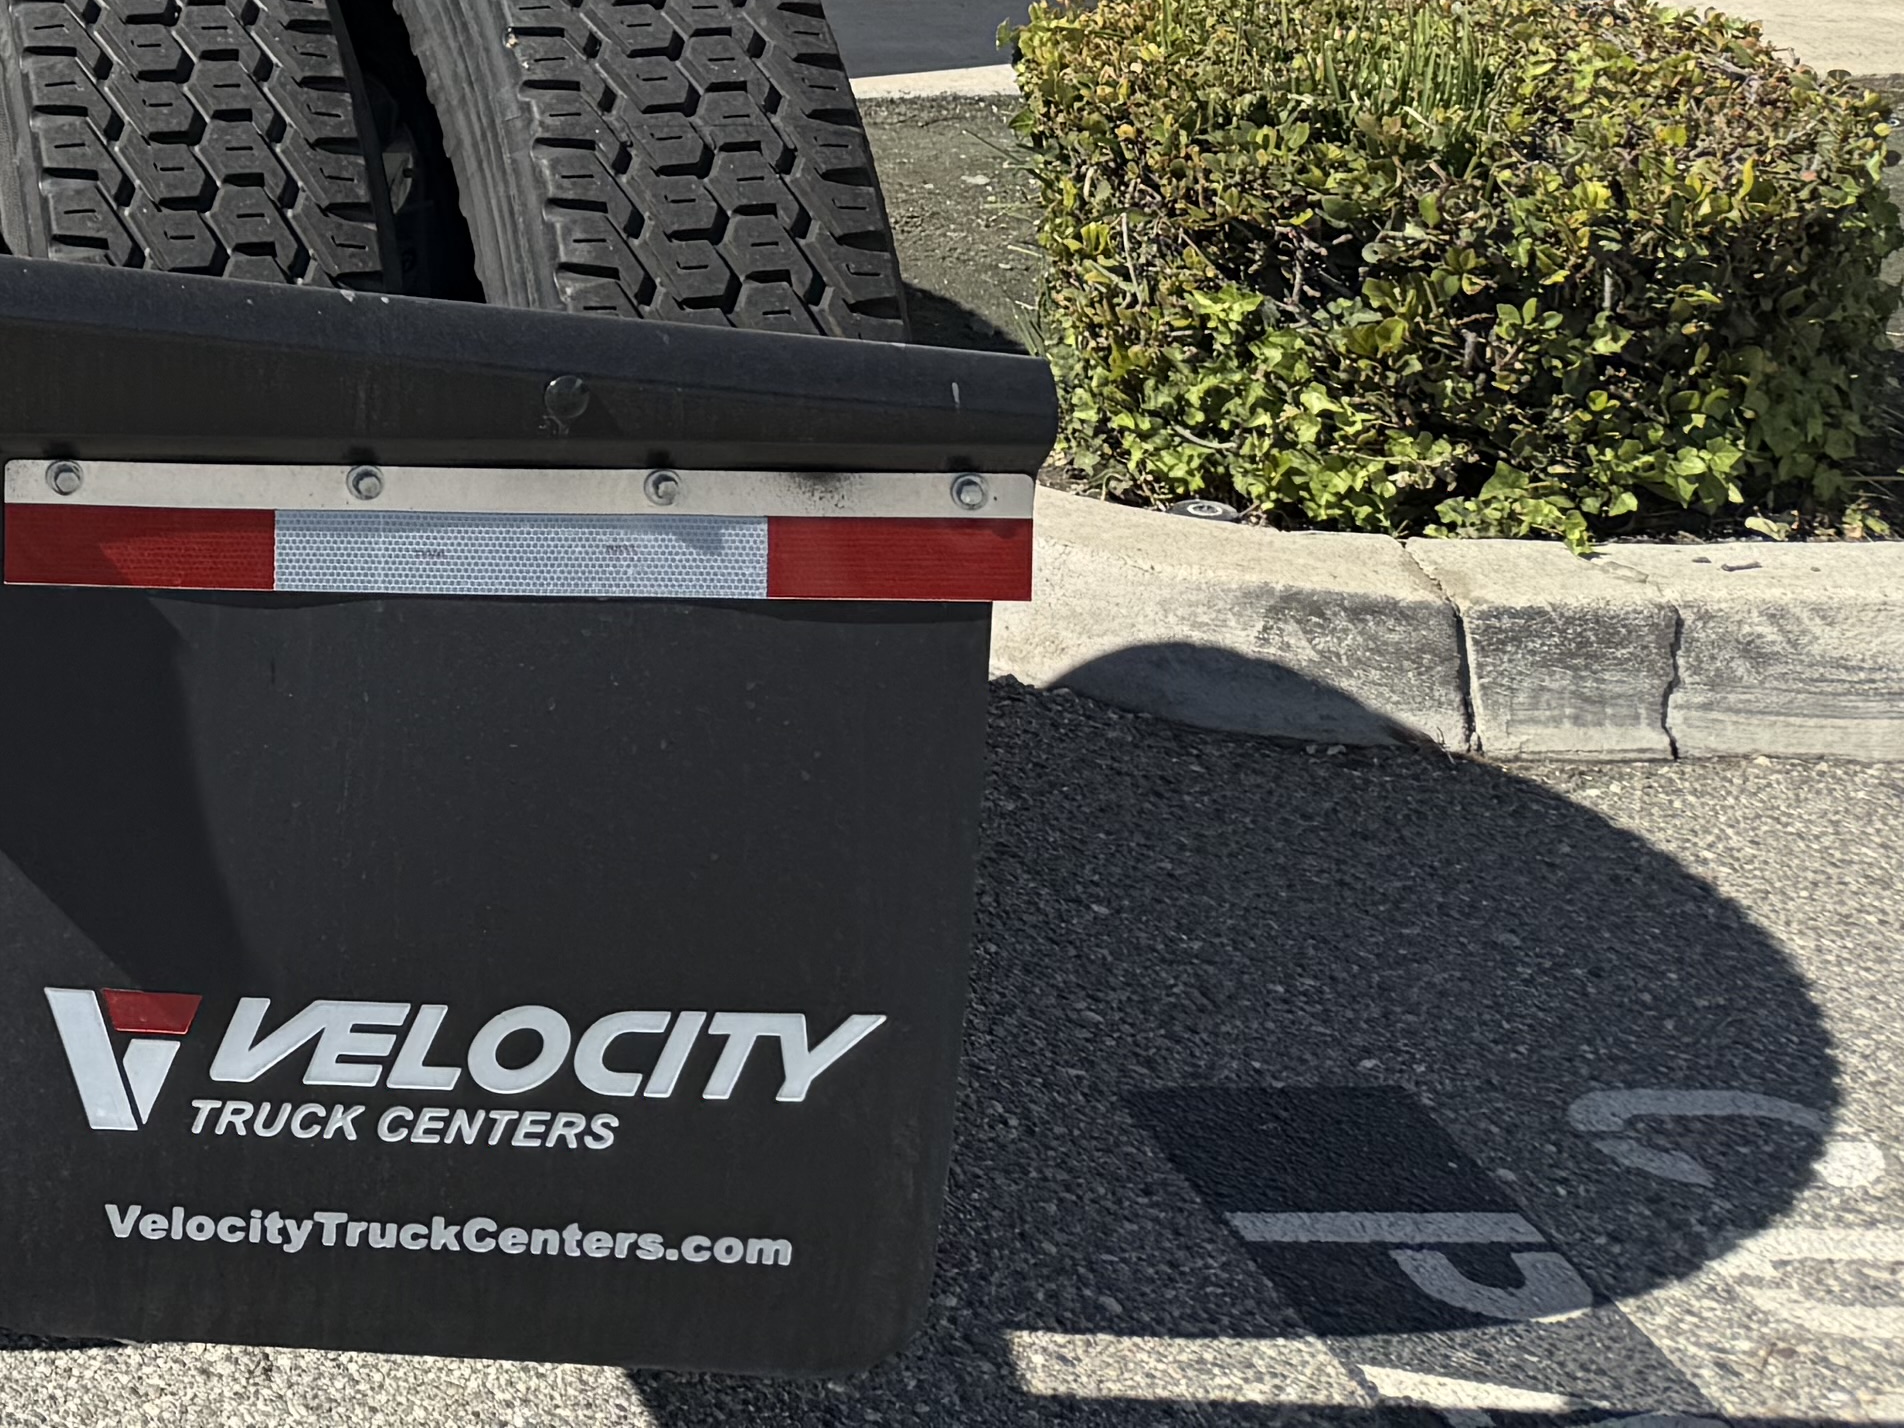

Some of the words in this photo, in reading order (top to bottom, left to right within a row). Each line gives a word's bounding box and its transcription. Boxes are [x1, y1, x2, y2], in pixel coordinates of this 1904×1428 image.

[210, 998, 886, 1102] VELOCITY
[191, 1100, 365, 1140] TRUCK
[378, 1106, 619, 1149] CENTERS
[105, 1204, 792, 1265] VelocityTruckCenters.com
